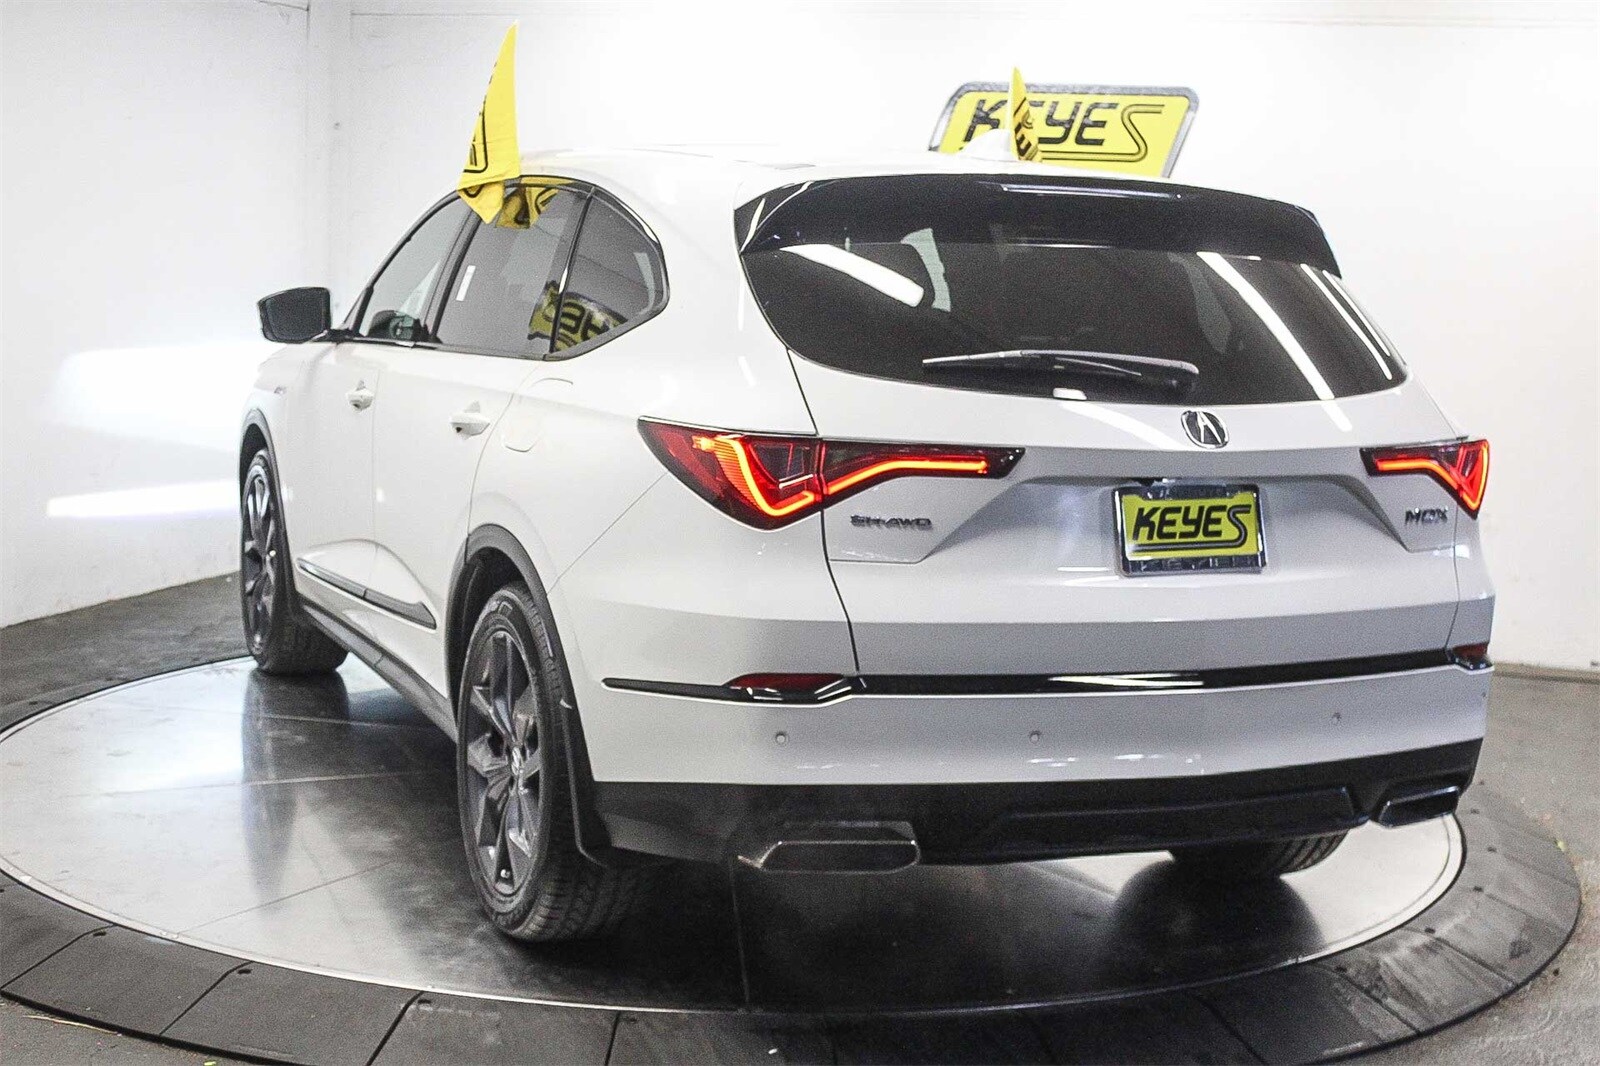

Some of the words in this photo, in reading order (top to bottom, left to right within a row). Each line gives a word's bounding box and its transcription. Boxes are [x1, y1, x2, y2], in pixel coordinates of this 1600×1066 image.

[963, 99, 1166, 162] KYES
[1132, 504, 1252, 552] KEYES
[1404, 507, 1449, 526] MDX
